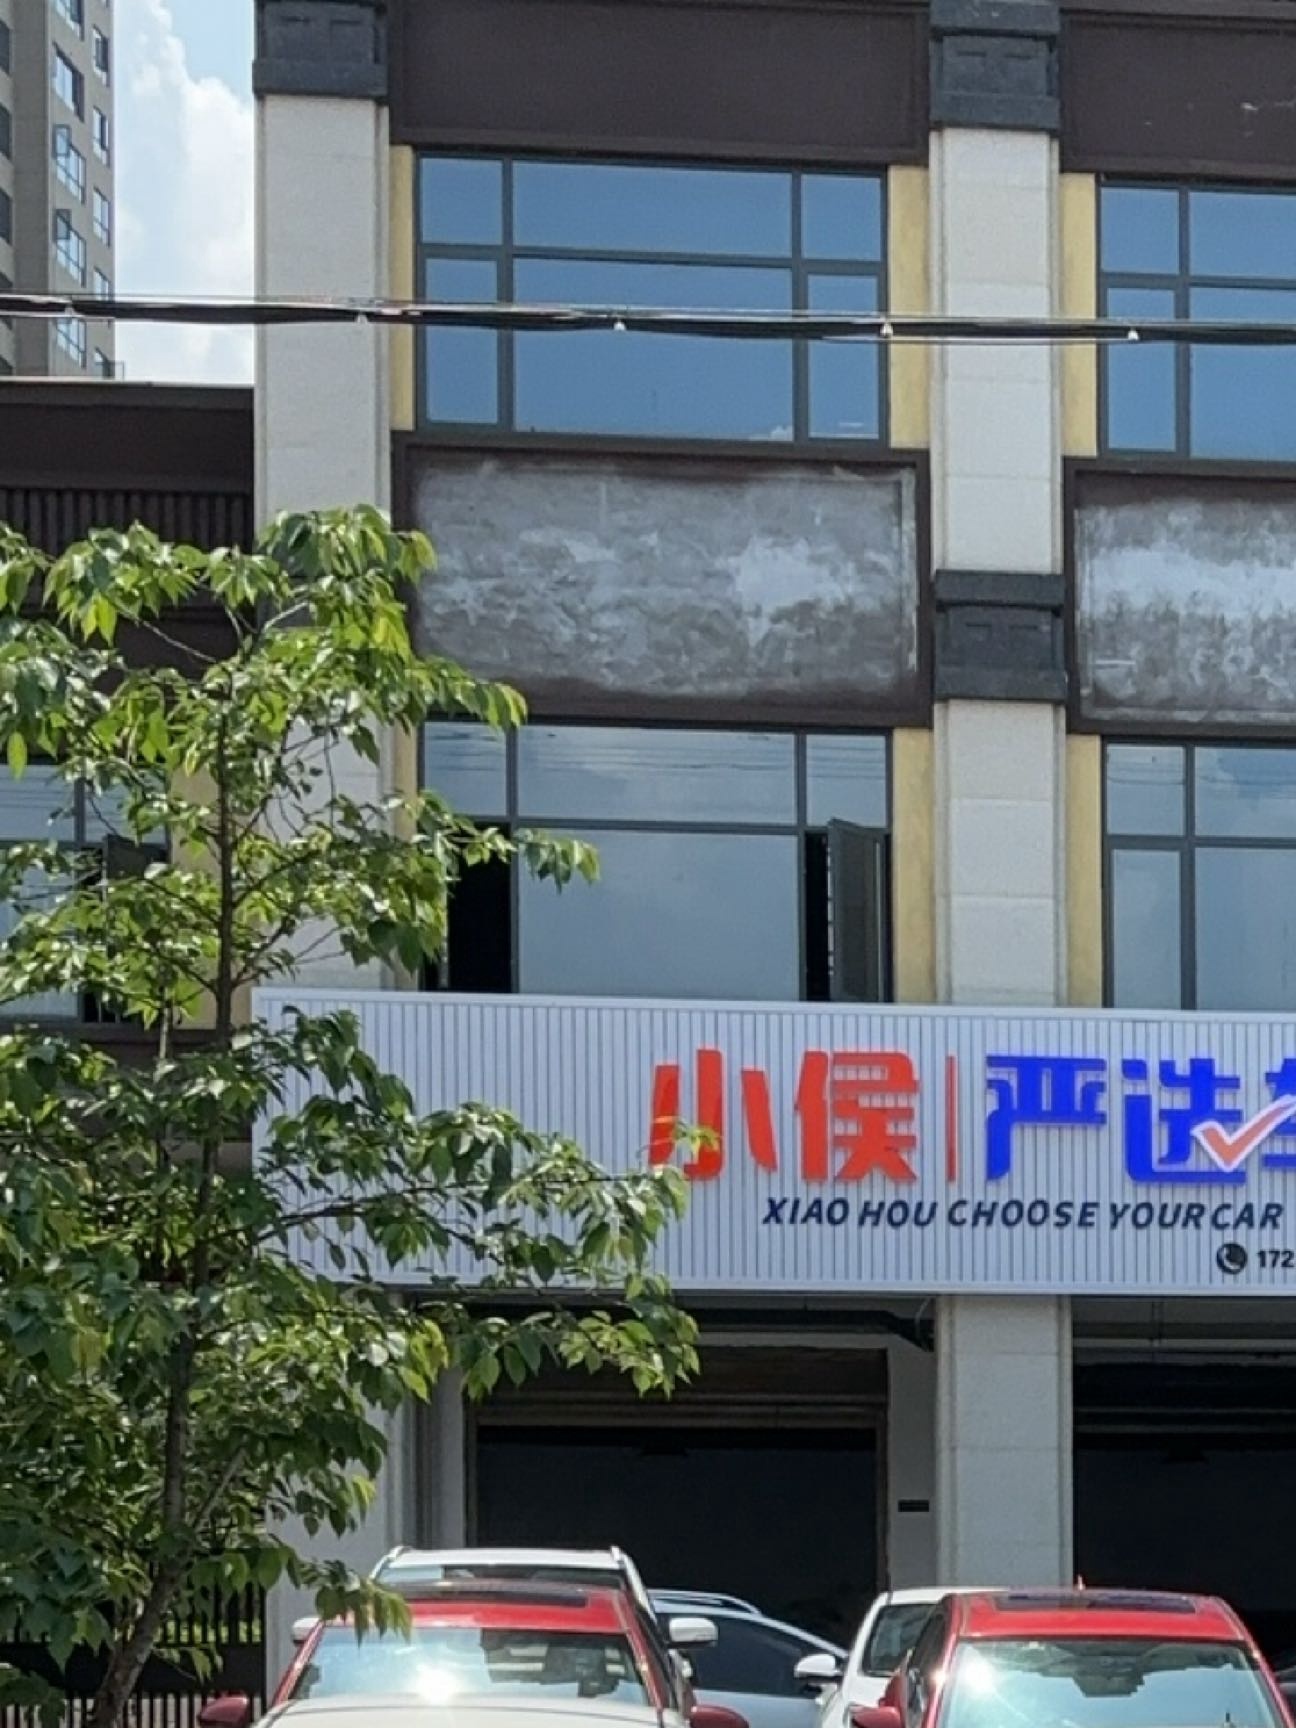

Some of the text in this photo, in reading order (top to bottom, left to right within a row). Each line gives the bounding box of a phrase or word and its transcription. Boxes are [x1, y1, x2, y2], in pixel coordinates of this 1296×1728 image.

[648, 1049, 920, 1183] 小侯
[763, 1197, 1285, 1231] XIAO HOU CHOOSE YOUR CAR
